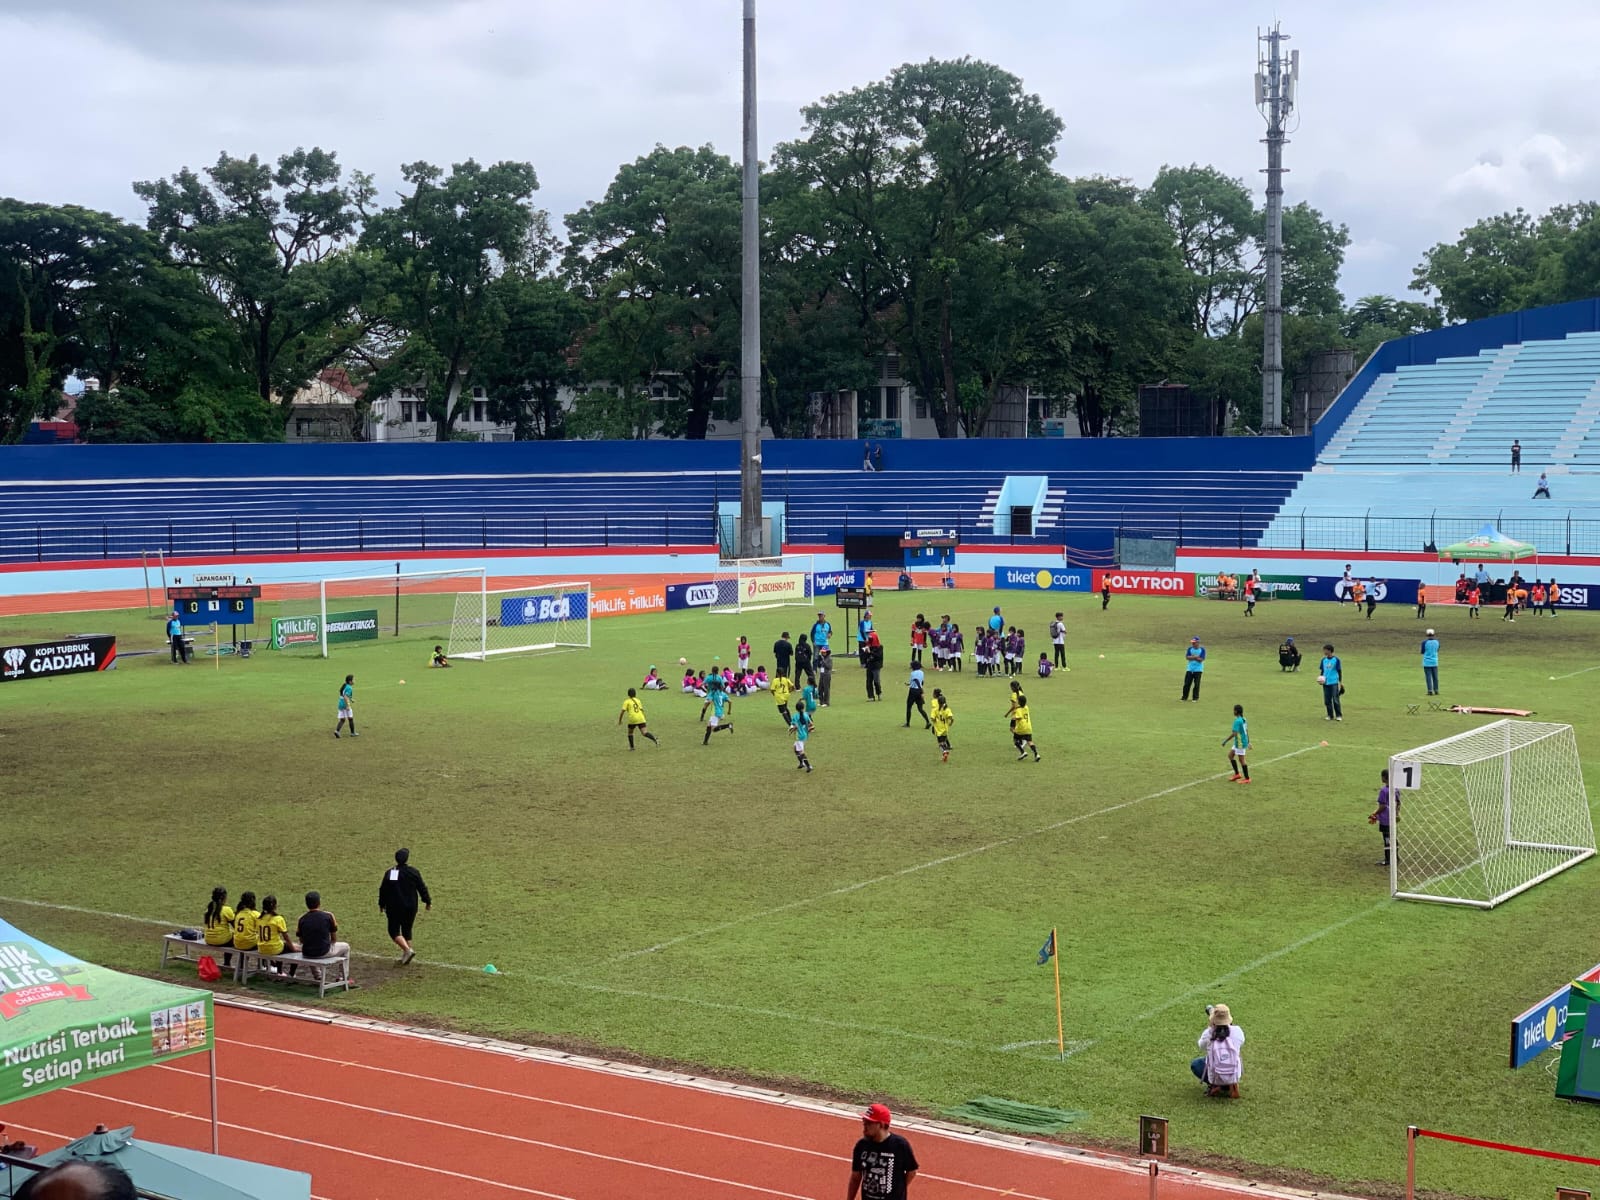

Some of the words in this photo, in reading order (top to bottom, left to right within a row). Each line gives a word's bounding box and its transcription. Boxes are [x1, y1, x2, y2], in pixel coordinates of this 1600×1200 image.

[758, 581, 795, 593] CROISSANT
[816, 573, 854, 590] hydroplus
[591, 598, 627, 613] MilkLife
[630, 594, 664, 609] MilkLife
[1557, 588, 1588, 604] SSI
[539, 598, 570, 619] BCA
[278, 619, 317, 634] MilkLife
[35, 648, 55, 656] KOPI
[57, 643, 89, 654] TUBRUK
[30, 652, 95, 672] GADJAH
[1403, 767, 1412, 787] 1
[237, 918, 244, 932] 5
[259, 925, 271, 941] 10
[0, 945, 40, 968] ilk
[0, 964, 59, 989] Life
[16, 985, 52, 998] SOCCER
[16, 990, 65, 1006] CHALLENGE
[3, 1031, 67, 1067] Nutrisi
[70, 1016, 138, 1048] Terbaik
[22, 1058, 82, 1088] Setiap
[86, 1042, 125, 1070] Hari
